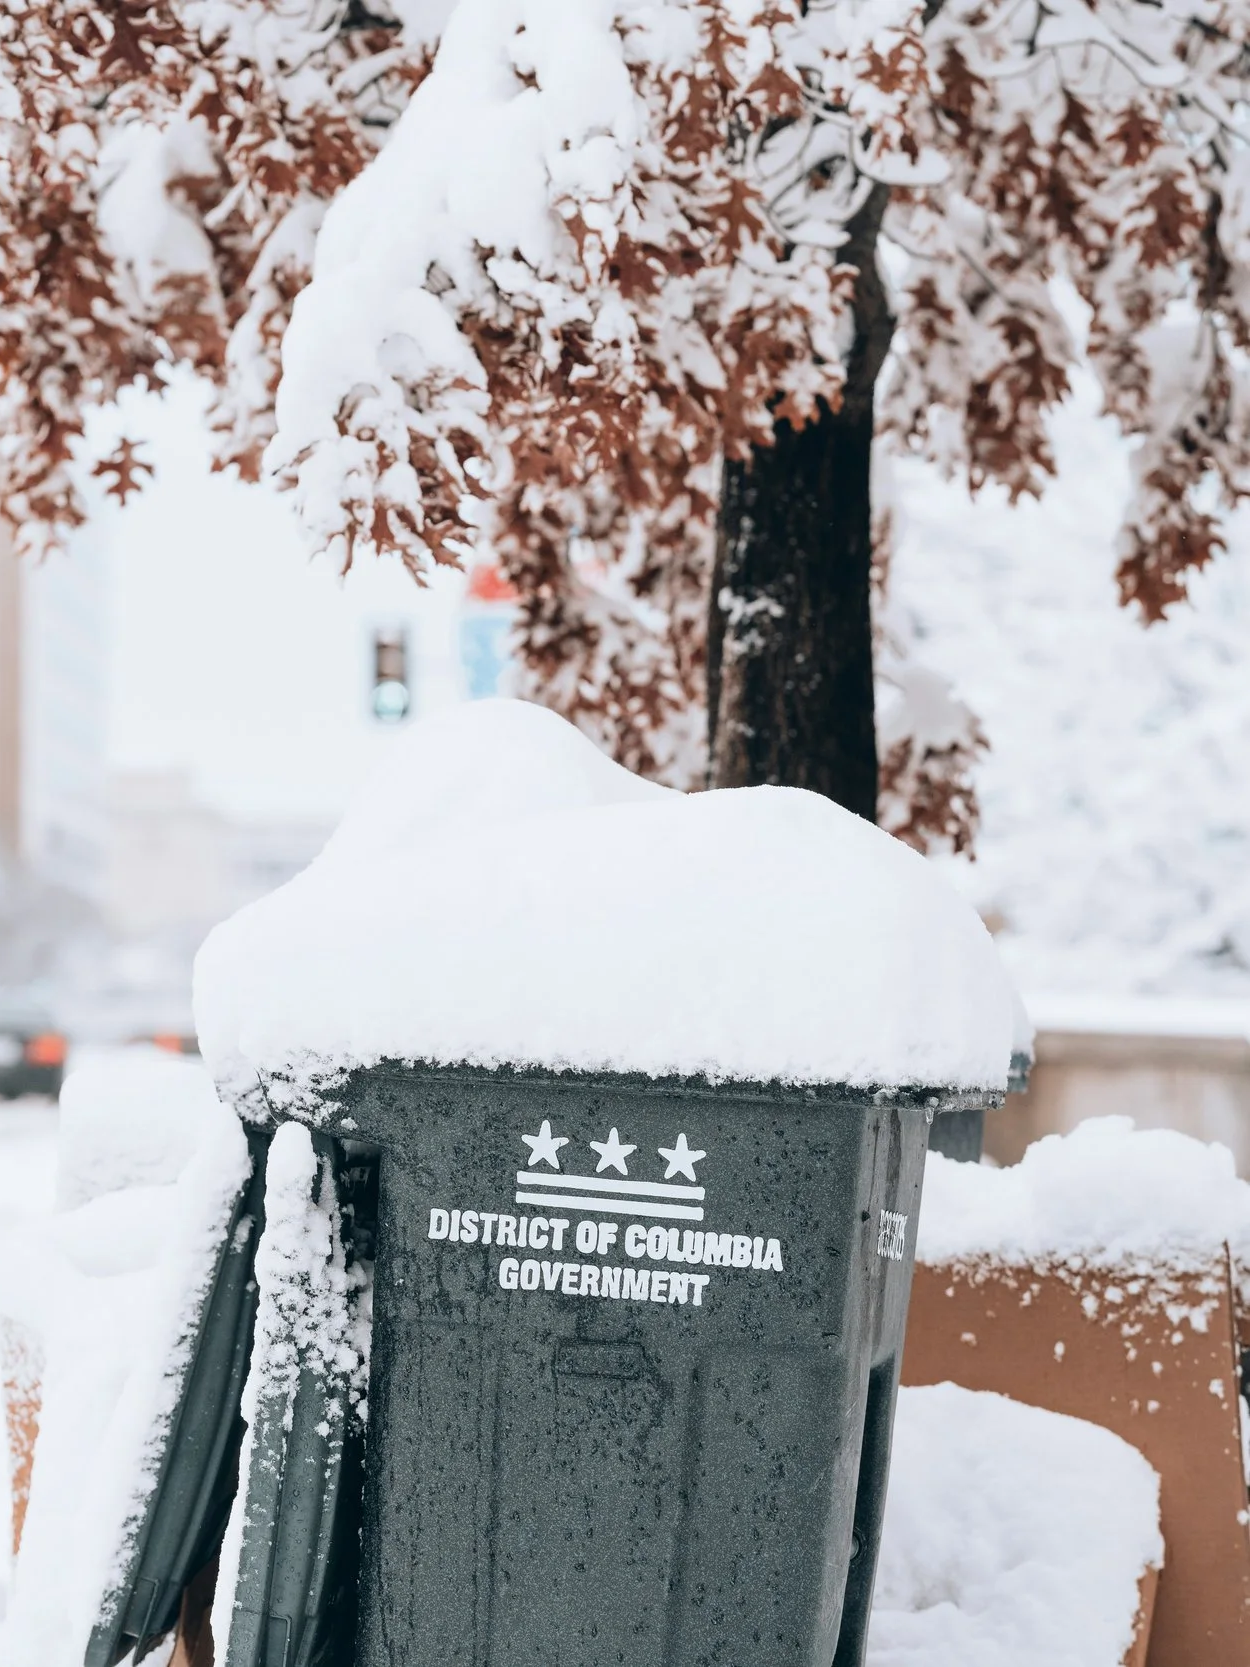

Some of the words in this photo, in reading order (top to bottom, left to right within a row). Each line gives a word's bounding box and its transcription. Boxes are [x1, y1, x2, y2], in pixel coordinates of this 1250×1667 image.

[427, 1207, 570, 1251] DISTRICT
[575, 1220, 618, 1256] OF
[624, 1223, 784, 1272] COLUMBIA
[498, 1257, 711, 1307] GOVERNMENT
